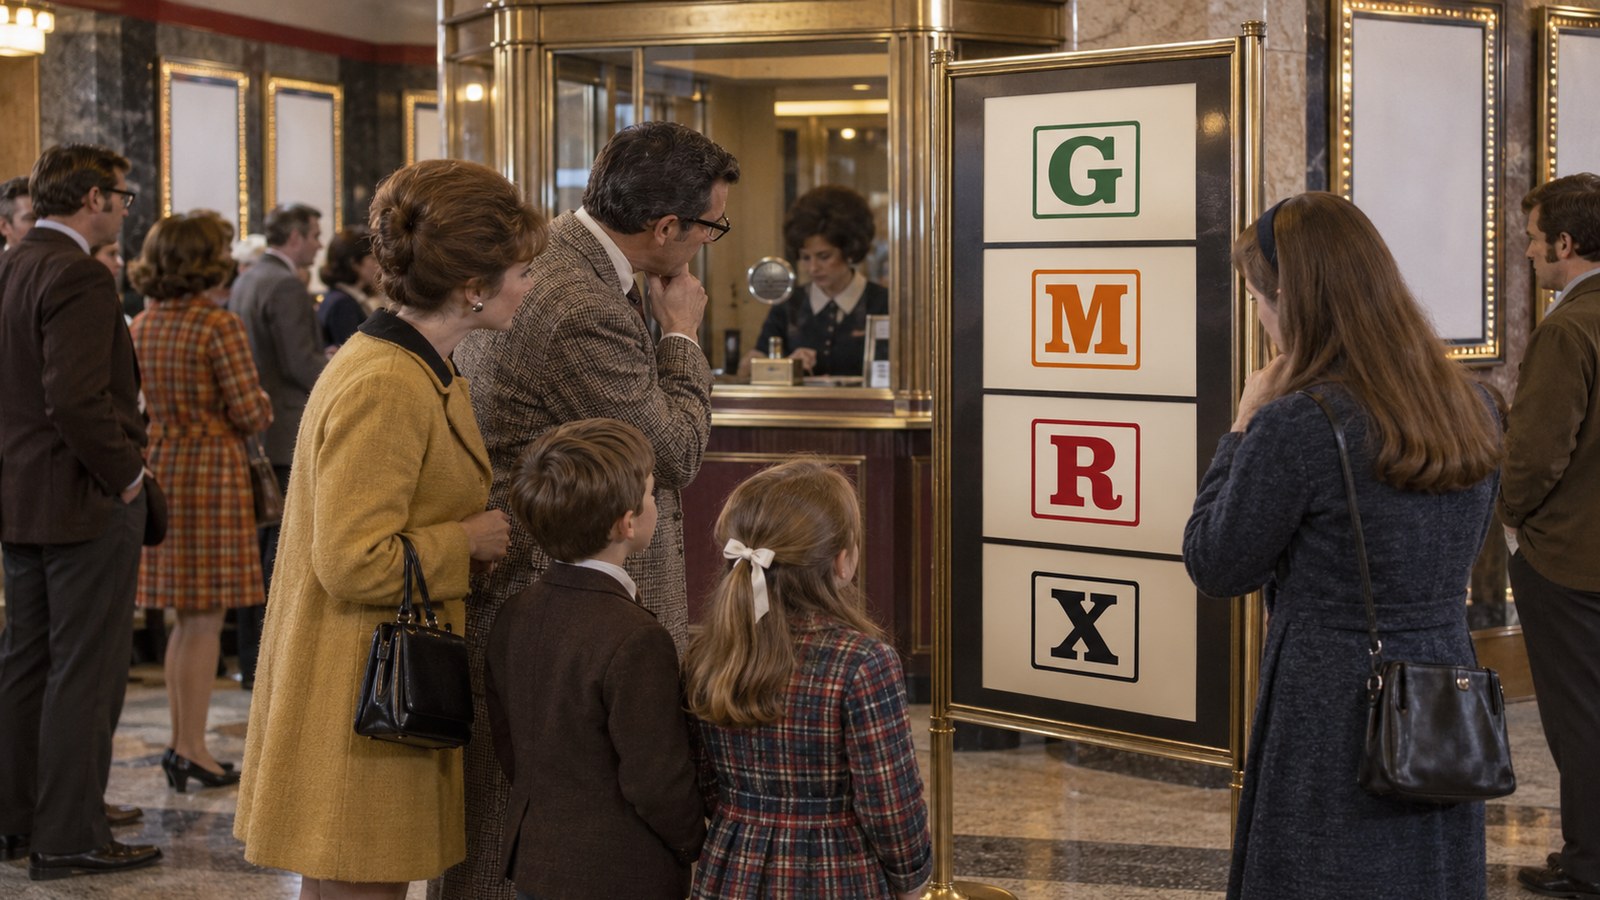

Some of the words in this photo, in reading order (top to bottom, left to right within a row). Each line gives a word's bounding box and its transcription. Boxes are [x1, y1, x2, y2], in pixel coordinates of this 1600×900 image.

[1048, 136, 1122, 206] G
[1045, 285, 1127, 354] M
[1050, 435, 1122, 510] R
[1051, 588, 1119, 666] X
